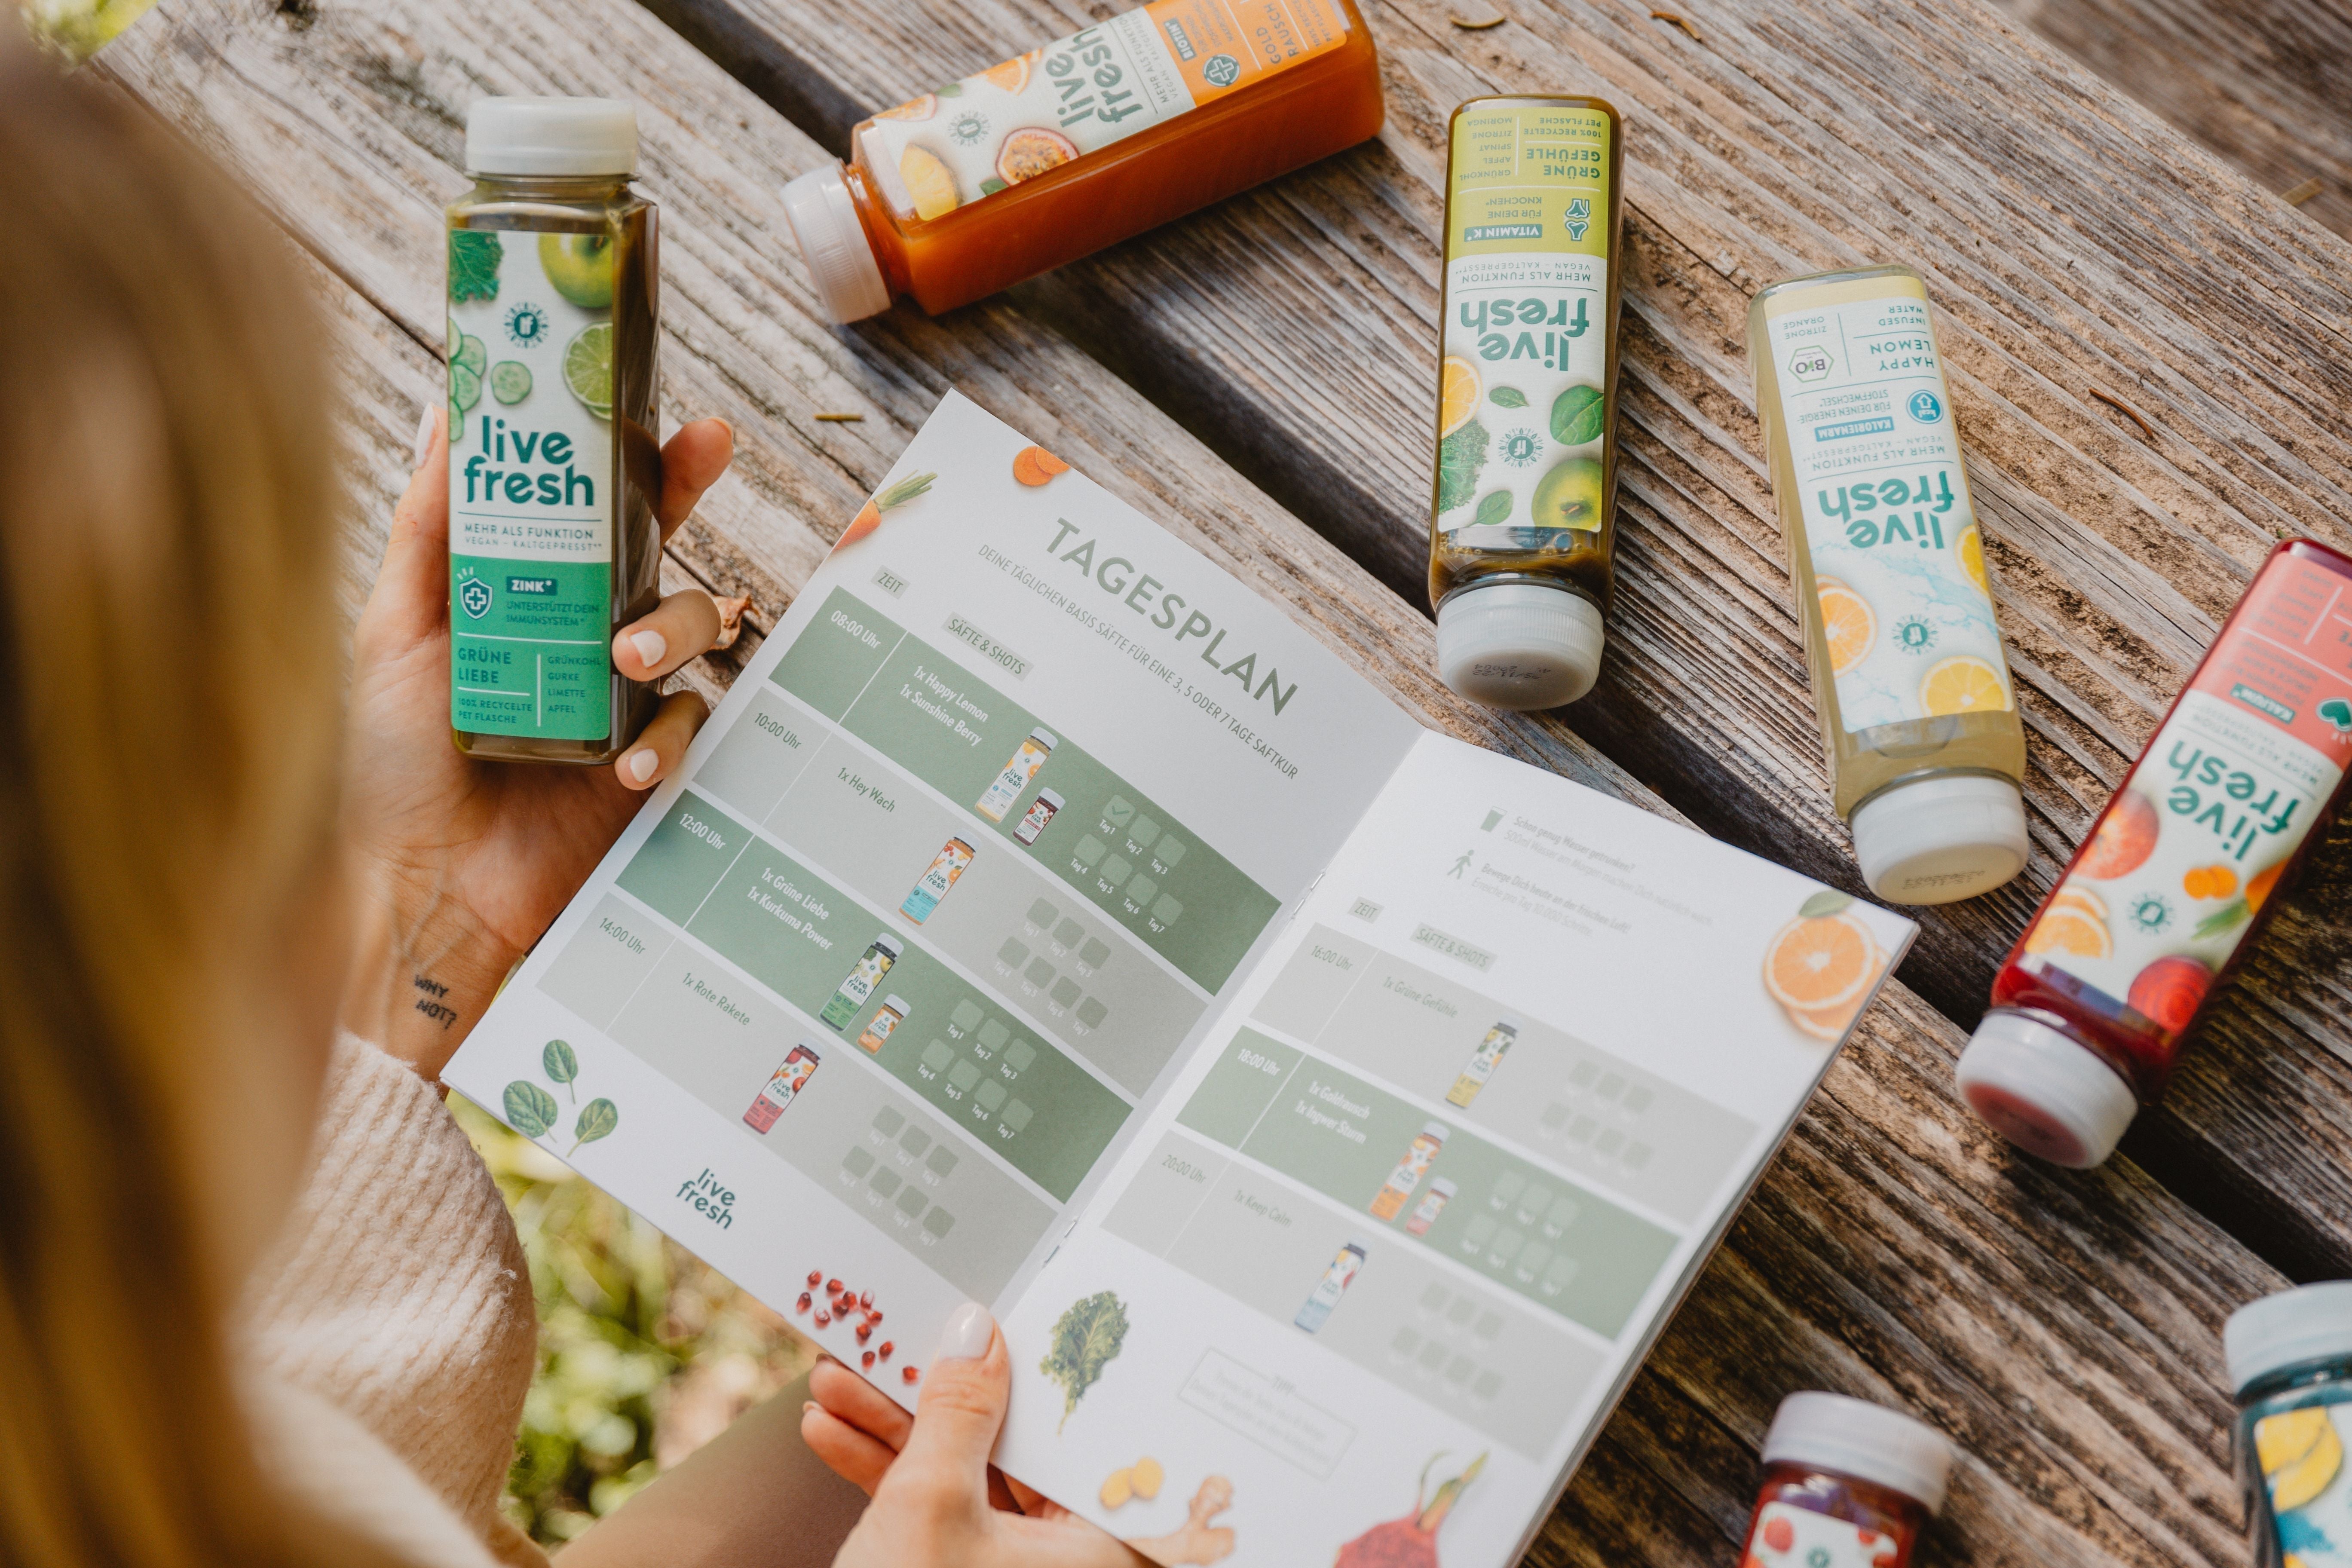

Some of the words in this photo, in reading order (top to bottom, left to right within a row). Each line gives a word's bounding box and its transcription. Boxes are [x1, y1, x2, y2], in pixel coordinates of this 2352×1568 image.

[1264, 3, 1302, 60] RAUSCH
[1256, 27, 1284, 67] GOLD
[1140, 57, 1155, 72] ALS
[1070, 28, 1143, 123] fresh
[1045, 52, 1096, 128] live
[1150, 77, 1170, 103] MEHR
[1467, 117, 1512, 126] MORINGA
[1472, 130, 1512, 139] ZITRONE
[1580, 129, 1601, 138] 100%
[1527, 147, 1601, 163] GEFÜHLE
[1458, 169, 1511, 181] GRÜNKOHL
[1544, 164, 1601, 180] GRÜNE
[1487, 209, 1519, 218] DEINE
[1522, 209, 1542, 220] FÜR
[1485, 227, 1539, 237] VITAMIN
[1462, 272, 1524, 284] FUNKTION
[1556, 273, 1591, 282] MEHR
[1461, 298, 1590, 338] fresh
[1888, 305, 1924, 314] WATER
[1783, 316, 1825, 330] ORANGE
[1878, 317, 1926, 327] INFUSED
[1785, 326, 1827, 340] ZITRONE
[1478, 331, 1570, 371] live
[1870, 339, 1931, 354] LEMON
[1880, 356, 1935, 371] HAPPY
[1838, 404, 1871, 416] DEINEN
[1873, 401, 1891, 412] FÜR
[1818, 420, 1891, 438] KALORIENARM
[478, 416, 574, 465] live
[1906, 435, 1943, 444] VEGAN
[1883, 449, 1904, 459] ALS
[1911, 446, 1945, 456] MEHR
[1813, 453, 1878, 471] FUNKTION
[464, 456, 594, 506] fresh
[1818, 470, 1955, 527] fresh
[465, 523, 497, 533] MEHR
[502, 527, 522, 536] ALS
[528, 527, 593, 539] FUNKTION
[1845, 511, 1945, 550] live
[466, 536, 498, 545] VEGAN
[878, 573, 903, 592] ZEIT
[507, 601, 572, 612] UNTERSTÜTZT
[574, 604, 600, 613] DEIN
[1047, 518, 1298, 716] TAGESPLAN
[831, 610, 863, 636] 08:00
[861, 630, 881, 648] Uhr
[948, 619, 982, 646] SÄFTE
[980, 640, 990, 652] &
[989, 646, 1025, 674] SHOTS
[459, 648, 511, 665] GRÜNE
[548, 655, 603, 667] GRÜNKOHL
[978, 545, 1012, 571] DEINE
[1011, 564, 1068, 608] TÄGLICHEN
[1066, 602, 1097, 628] BASIS
[1096, 622, 1130, 650] SÄFTE
[1127, 644, 1150, 665] FÜR
[1148, 659, 1176, 683] EINE
[1173, 677, 1183, 693] 3,
[1184, 685, 1194, 697] 5
[1192, 692, 1222, 719] ODER
[1219, 712, 1230, 723] 7
[1228, 717, 1256, 744] TAGE
[1253, 738, 1298, 779] SAFTKUR
[459, 669, 499, 683] LIEBE
[548, 672, 579, 681] GURKE
[548, 689, 586, 698] LIMETTE
[914, 666, 926, 680] 1x
[925, 673, 957, 702] Happy
[956, 693, 988, 722] Lemon
[461, 698, 477, 707] 100%
[480, 700, 532, 711] RECYCELTE
[548, 704, 576, 713] APFEL
[459, 711, 472, 720] PET
[475, 713, 516, 723] FLASCHE
[900, 684, 913, 698] 1x
[911, 692, 955, 726] Sunshine
[954, 720, 982, 746] Berry
[754, 713, 784, 737] 10:00
[783, 731, 801, 749] Uhr
[1002, 772, 1021, 789] fresh
[1009, 769, 1023, 781] live
[838, 767, 849, 781] 1x
[848, 775, 869, 796] Hey
[869, 787, 894, 812] Wach
[2168, 741, 2300, 834] fresh
[680, 814, 708, 838] 12:00
[706, 831, 726, 849] Uhr
[1099, 819, 1110, 833] Tag
[2167, 786, 2257, 861] live
[1126, 839, 1137, 853] Tag
[1152, 858, 1162, 872] Tag
[926, 874, 945, 891] fresh
[931, 870, 947, 884] live
[762, 867, 774, 882] 1x
[773, 876, 802, 902] Grüne
[802, 894, 829, 920] Liebe
[747, 886, 760, 901] 1x
[758, 894, 802, 930] Kurkuma
[801, 922, 833, 950] Power
[1354, 902, 1378, 918] ZEIT
[600, 918, 628, 942] 14:00
[627, 936, 646, 954] Uhr
[1416, 928, 1449, 949] SÄFTE
[1446, 941, 1455, 952] &
[1455, 945, 1489, 968] SHOTS
[1311, 945, 1337, 963] 16:00
[1335, 956, 1353, 971] Uhr
[414, 974, 450, 998] WHY
[847, 980, 867, 996] fresh
[852, 975, 867, 989] live
[683, 973, 694, 987] 1x
[693, 980, 717, 1002] Rote
[717, 996, 750, 1025] Rakete
[1383, 977, 1394, 989] 1x
[1394, 981, 1422, 1001] Grüne
[1422, 994, 1458, 1018] Gefühle
[415, 1000, 457, 1029] NOT?
[1237, 1049, 1265, 1068] 18:00
[1262, 1060, 1280, 1075] Uhr
[1309, 1081, 1321, 1095] 1x
[1319, 1086, 1370, 1119] Goldrausch
[1162, 1155, 1191, 1176] 20:00
[1189, 1168, 1206, 1183] Uhr
[698, 1168, 735, 1206] live
[677, 1180, 732, 1229] fresh
